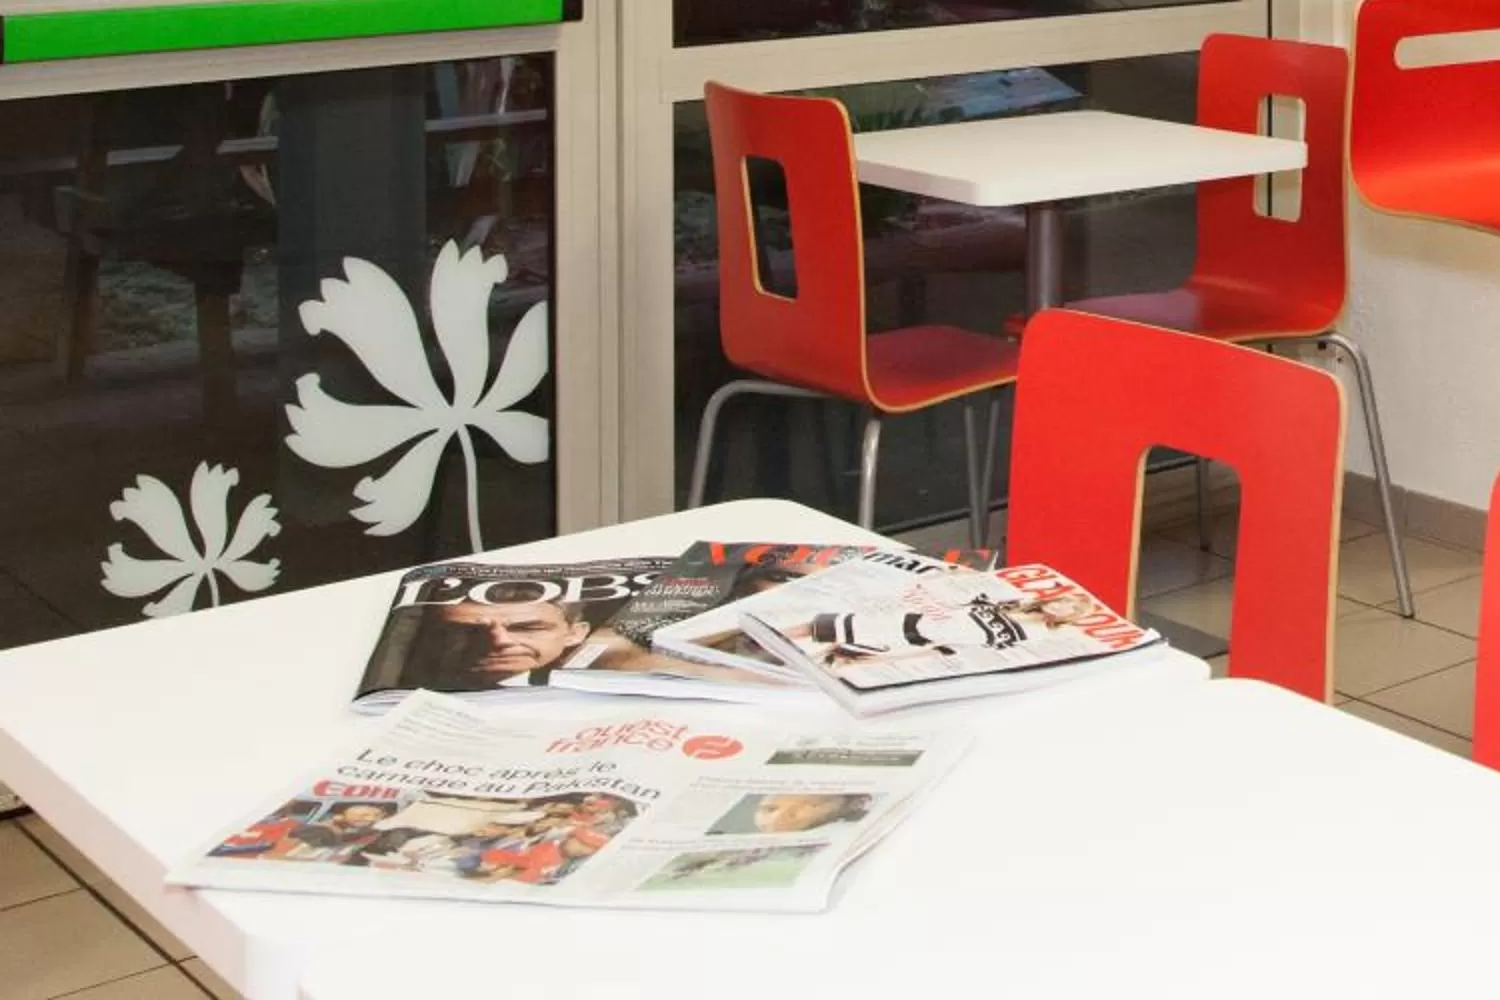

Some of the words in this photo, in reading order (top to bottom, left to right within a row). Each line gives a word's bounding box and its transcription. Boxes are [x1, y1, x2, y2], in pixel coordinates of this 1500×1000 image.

[997, 564, 1145, 650] GLAOUR
[355, 748, 398, 765] Le
[403, 754, 484, 778] choc
[589, 759, 617, 773] le
[336, 764, 470, 791] carnage
[473, 780, 517, 793] au
[522, 776, 663, 800] Pakistan
